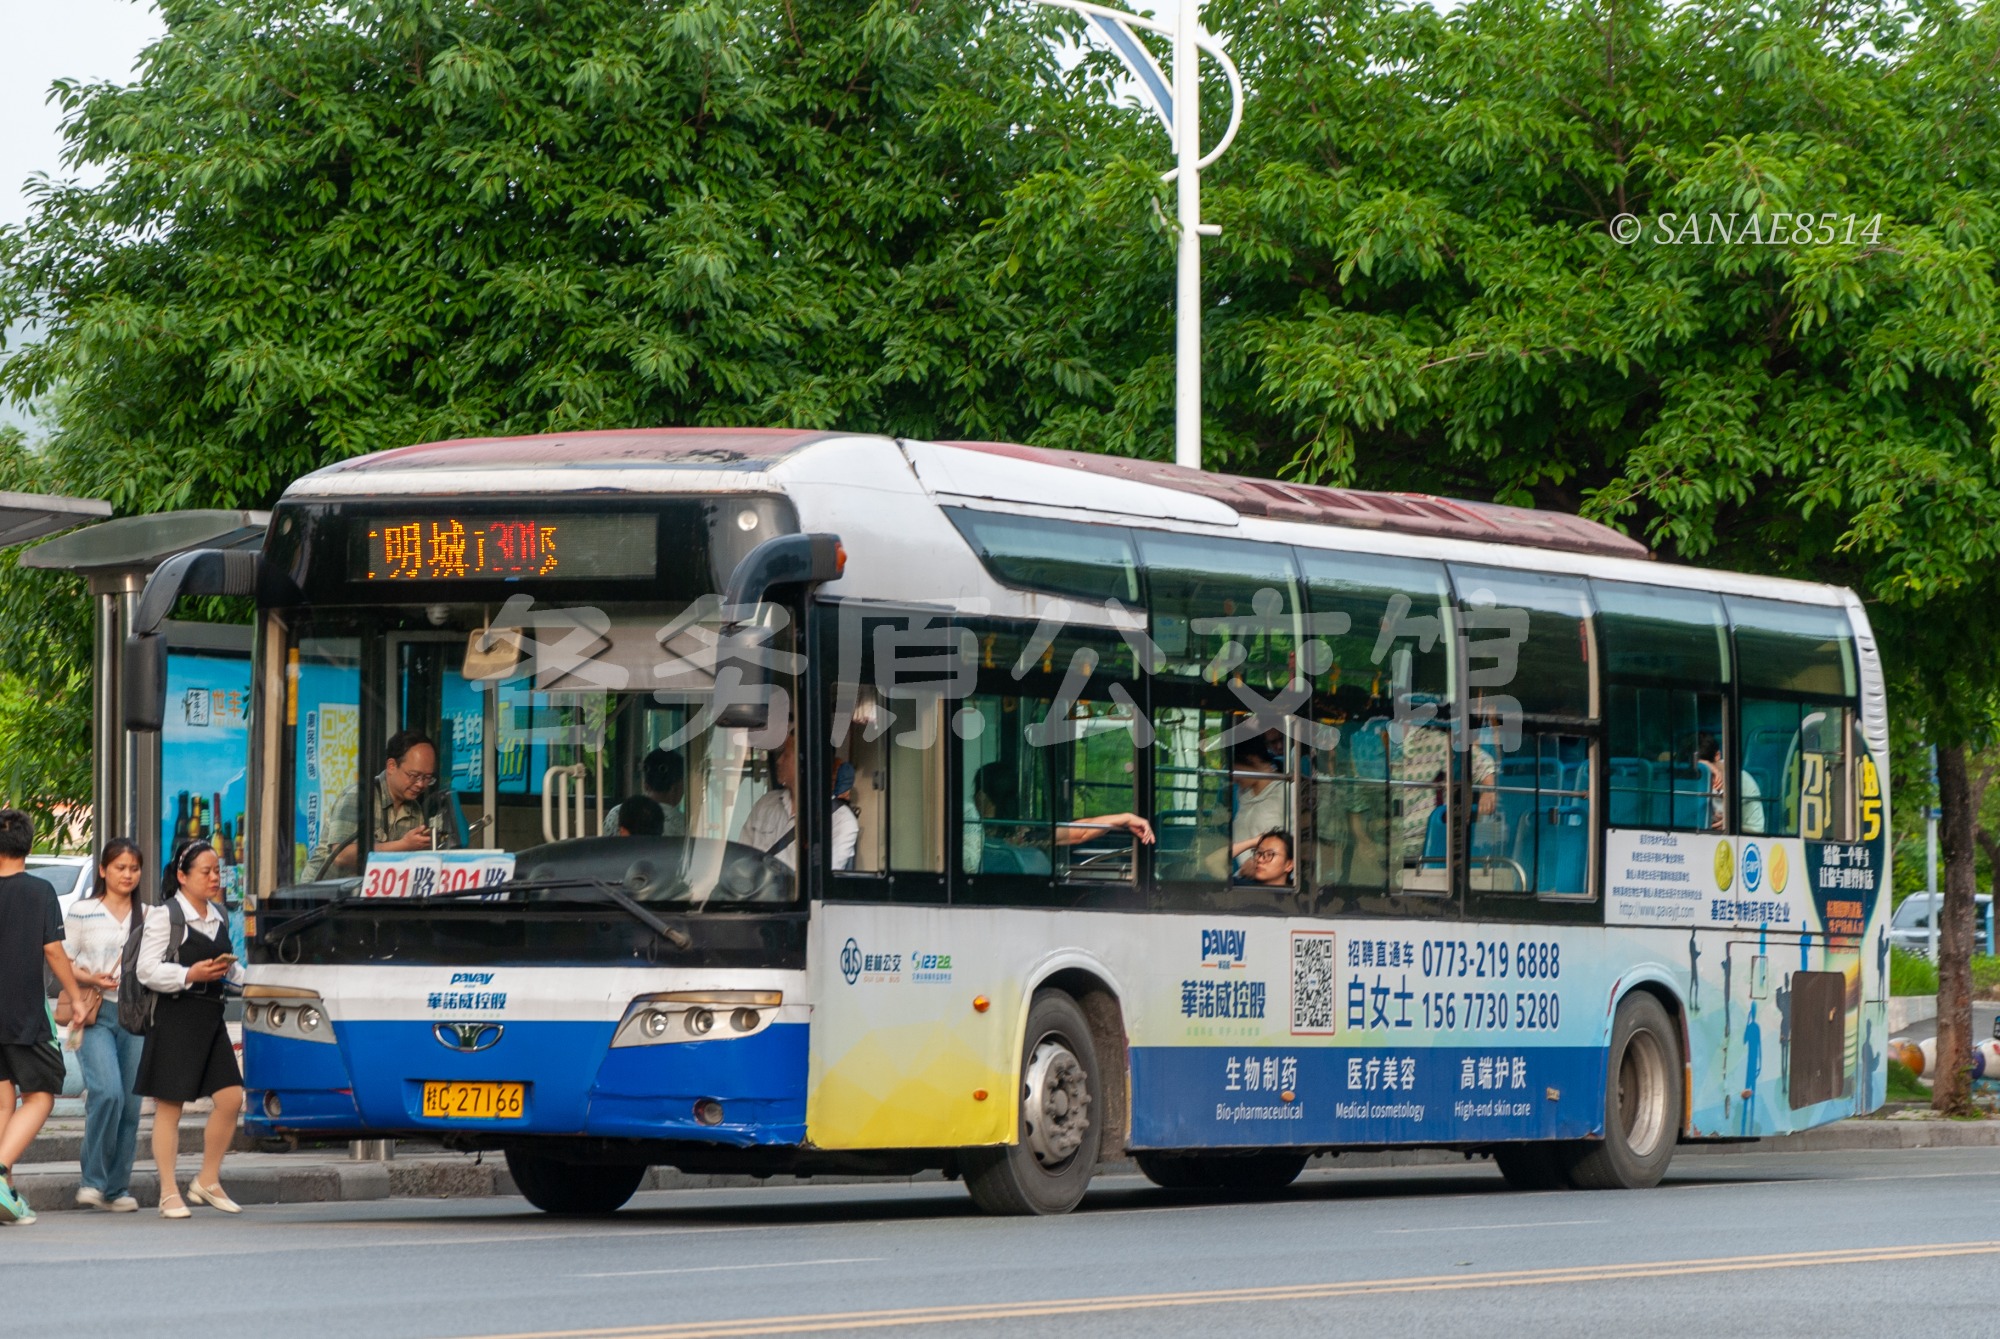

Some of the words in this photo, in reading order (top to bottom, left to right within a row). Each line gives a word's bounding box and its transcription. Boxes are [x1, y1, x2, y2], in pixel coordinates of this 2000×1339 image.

[364, 866, 436, 898] 301路
[1201, 929, 1247, 961] pavay
[1347, 939, 1414, 968] 招聘直通车
[1422, 939, 1510, 978] 0773-219
[1516, 941, 1560, 979] 6888
[450, 973, 495, 985] pavay
[427, 992, 507, 1010] 華諾威控股
[1181, 979, 1267, 1019] 華諾威控股
[1347, 973, 1415, 1030] 白女士
[1422, 991, 1456, 1029] 156
[1463, 992, 1509, 1029] 7730
[1516, 992, 1560, 1030] 5280
[1225, 1055, 1298, 1091] 生物制药
[1347, 1056, 1416, 1091] 医疗美容
[1460, 1055, 1527, 1090] 高端护肤
[1216, 1102, 1303, 1124] Bio-pharmaceutical
[1335, 1102, 1369, 1119] Medical
[1370, 1102, 1425, 1122] cosmetology
[1454, 1100, 1493, 1118] High-end
[1494, 1100, 1511, 1117] skin
[1512, 1103, 1531, 1117] care
